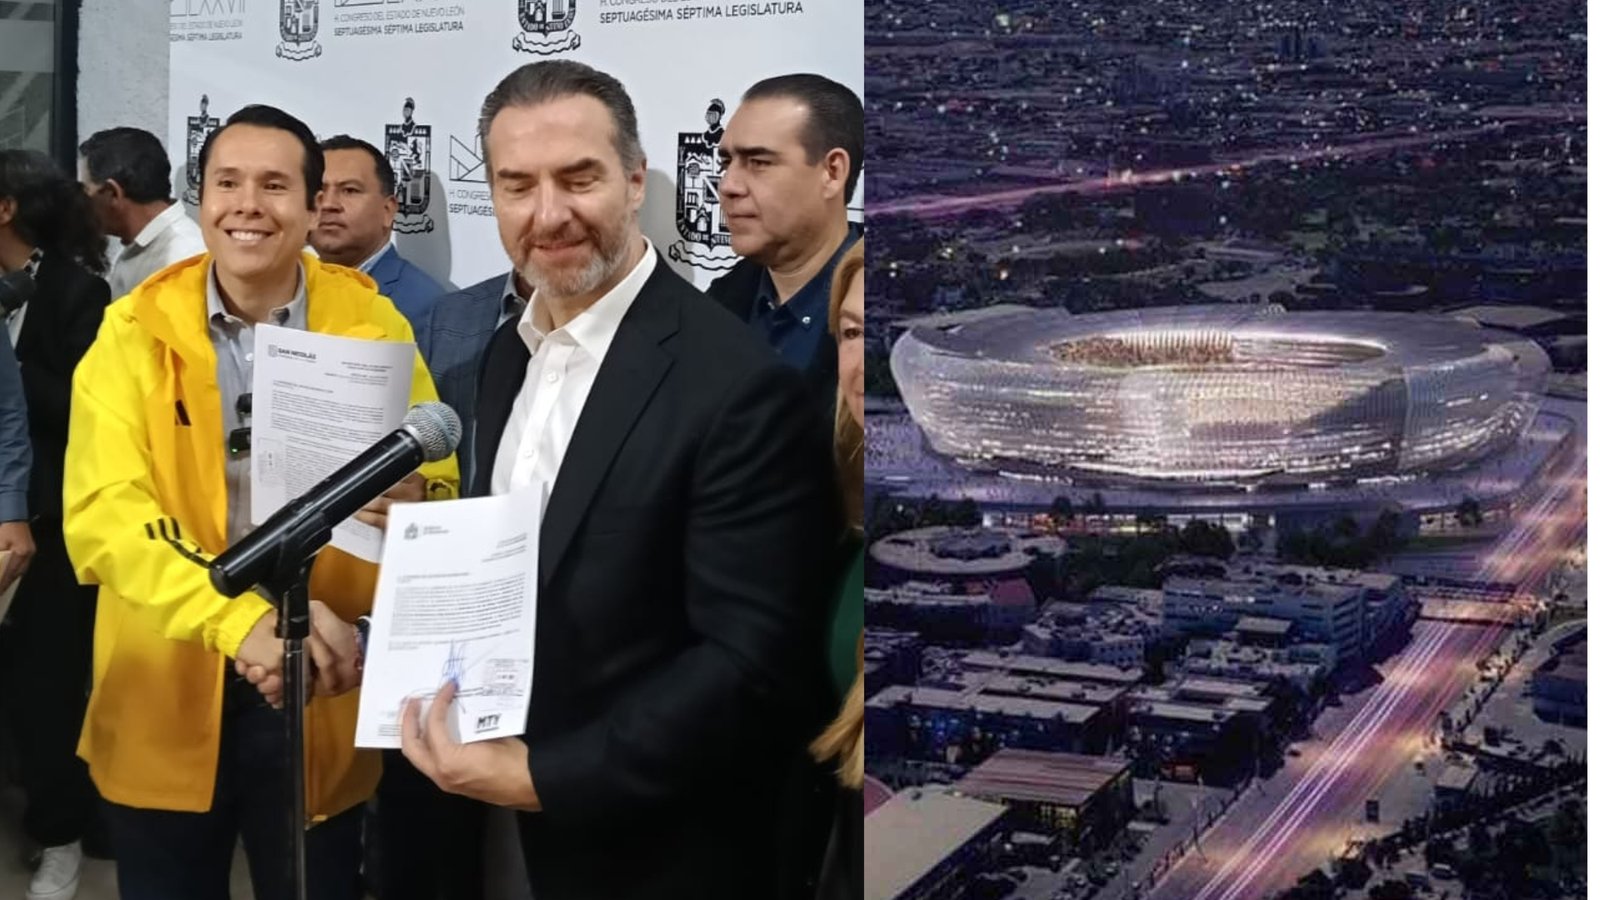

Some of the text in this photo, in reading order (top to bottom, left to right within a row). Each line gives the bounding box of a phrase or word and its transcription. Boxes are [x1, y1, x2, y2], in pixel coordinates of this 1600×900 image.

[600, 1, 803, 23] SEPTUAGÉSIMA SÉPTIMA LEGISLATURA
[415, 21, 464, 33] LEGISLATURA
[476, 713, 502, 728] MTY
